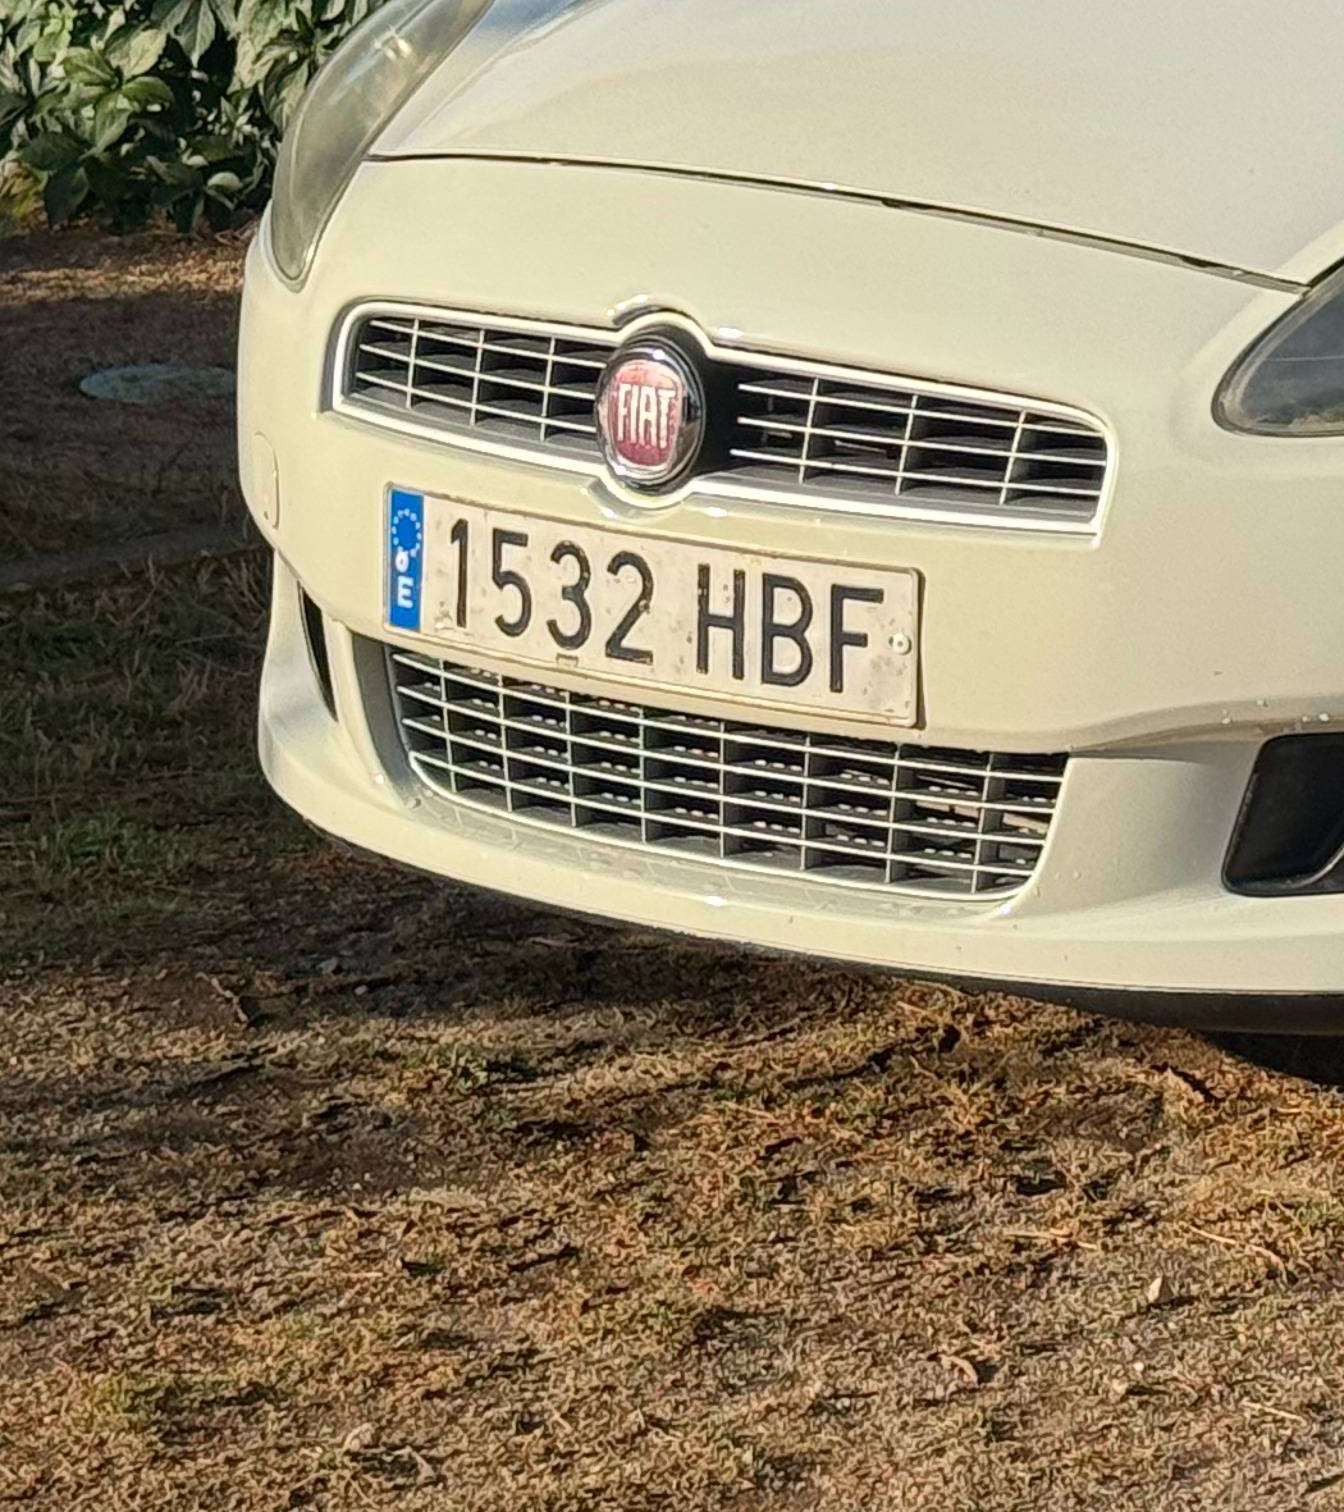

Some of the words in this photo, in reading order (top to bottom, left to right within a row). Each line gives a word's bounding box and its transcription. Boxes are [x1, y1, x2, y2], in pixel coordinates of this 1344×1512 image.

[617, 383, 677, 449] FIAT
[397, 575, 414, 608] E
[450, 517, 654, 666] 1532
[696, 563, 884, 693] HBF
